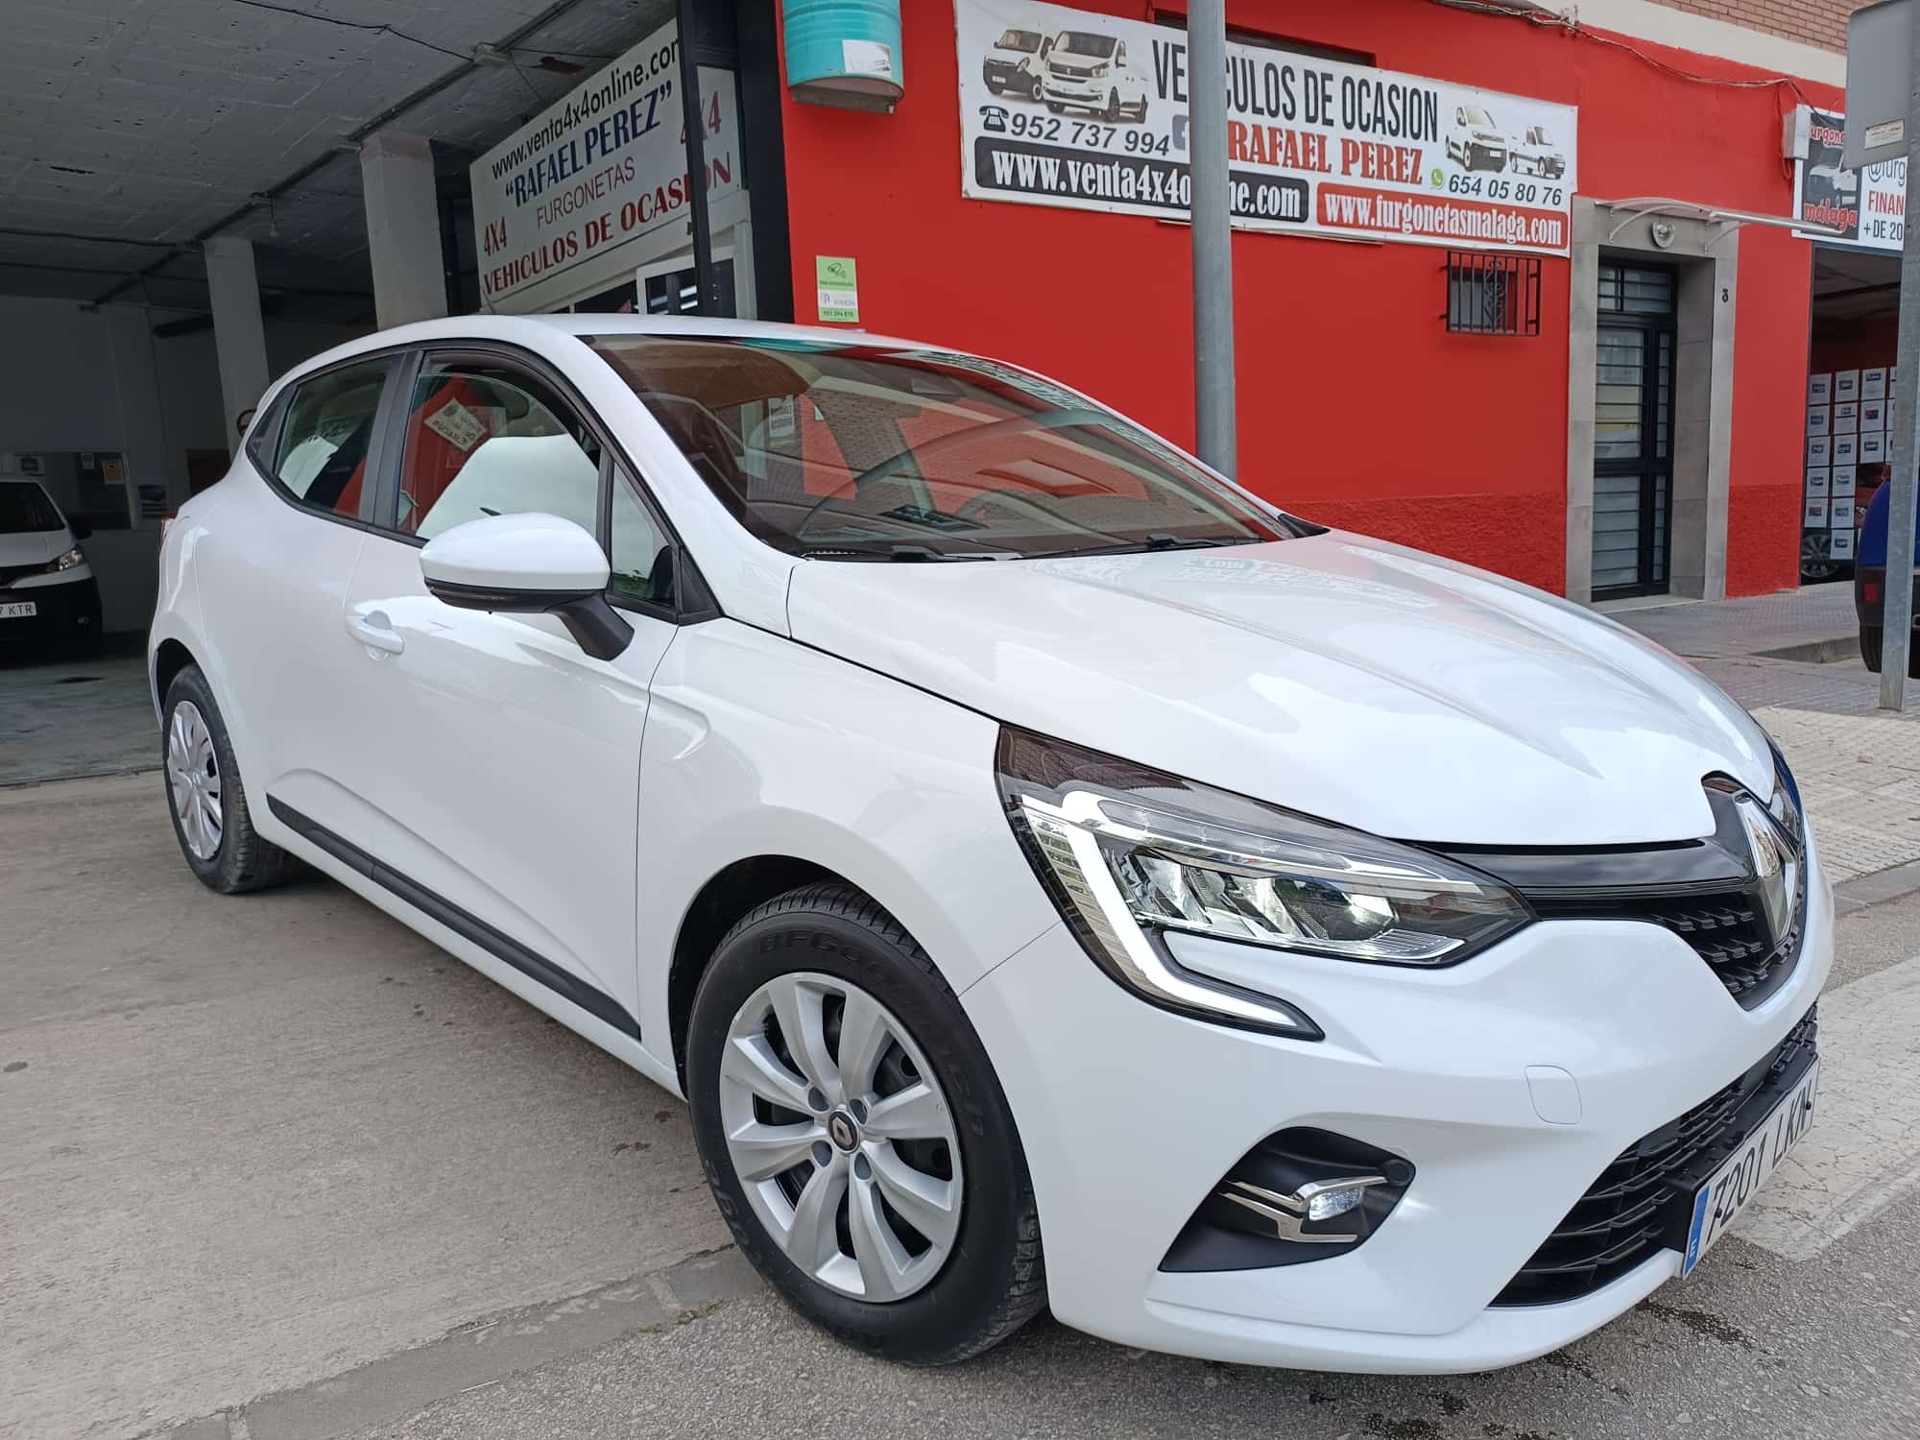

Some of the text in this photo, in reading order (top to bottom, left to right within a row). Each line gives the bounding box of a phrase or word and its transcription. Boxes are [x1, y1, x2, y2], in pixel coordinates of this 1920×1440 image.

[1304, 68, 1335, 127] DE
[1341, 75, 1439, 143] OCASION
[1010, 112, 1170, 156] 952 737 994
[1227, 120, 1423, 185] RAFAEL PEREZ
[484, 215, 508, 257] 4X4
[537, 156, 635, 230] FURGONETAS
[1448, 173, 1563, 206] 654 05 80 76
[1324, 192, 1562, 245] www.furgonetasmalaga.com
[1873, 219, 1887, 239] DE
[483, 230, 578, 295] VEHICULOS
[584, 212, 614, 249] DE
[1721, 288, 1729, 303] 3
[9, 604, 33, 616] KTR
[1706, 1131, 1768, 1245] 7201
